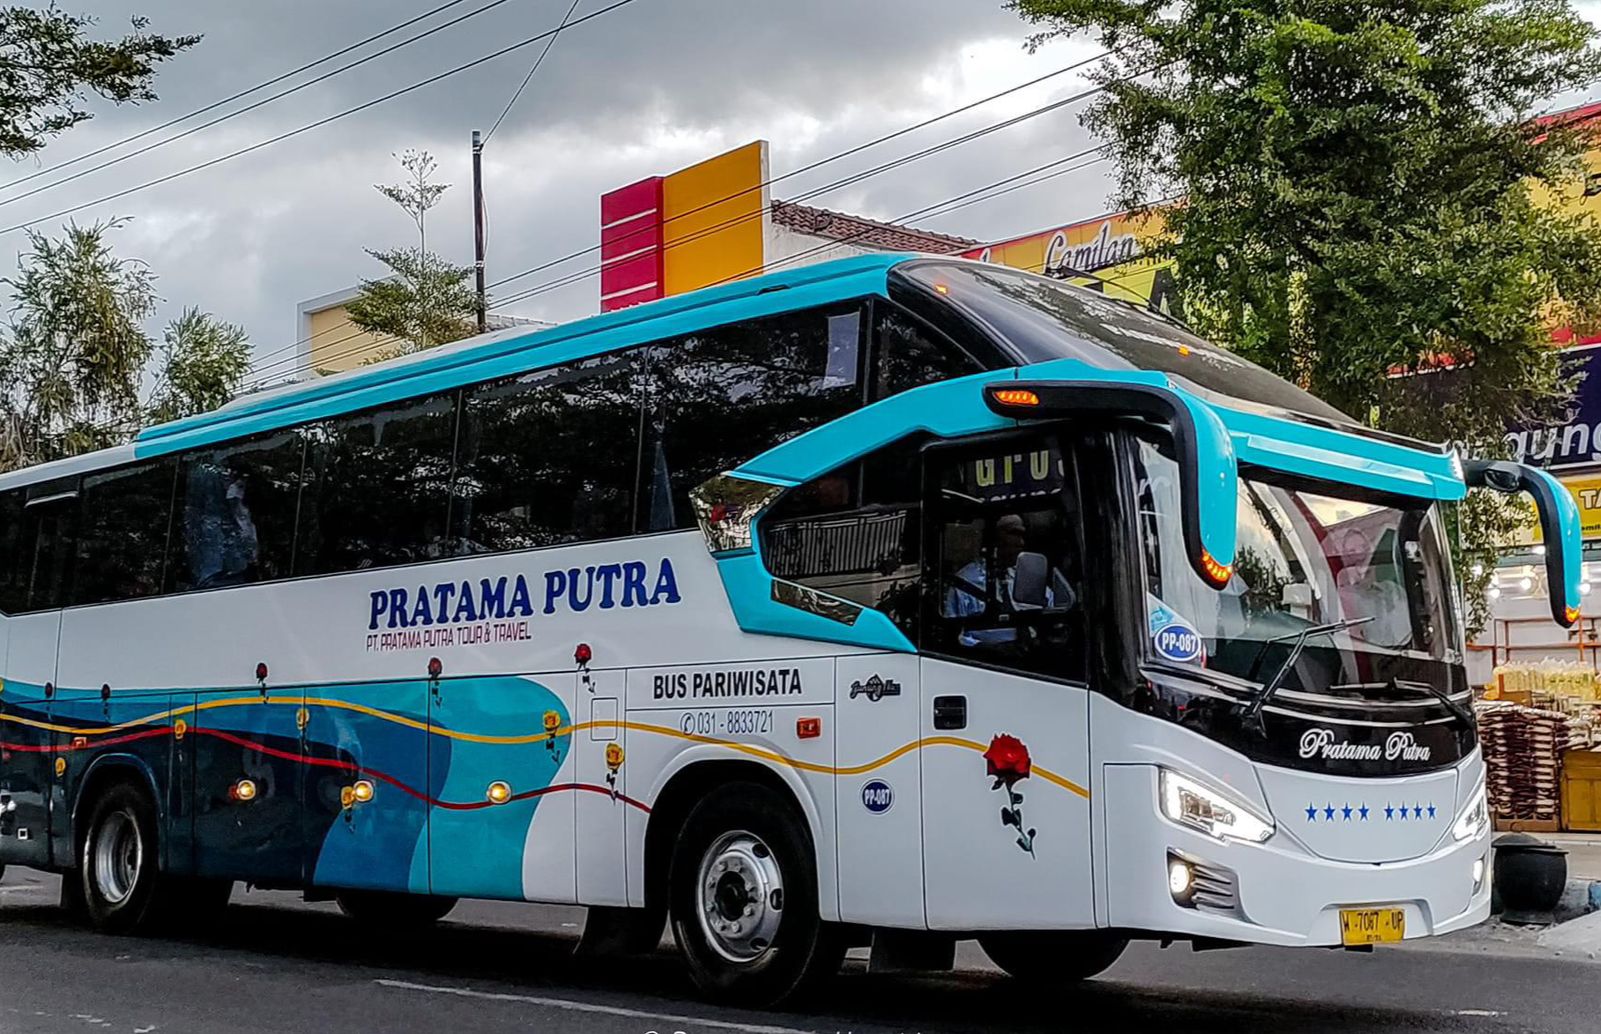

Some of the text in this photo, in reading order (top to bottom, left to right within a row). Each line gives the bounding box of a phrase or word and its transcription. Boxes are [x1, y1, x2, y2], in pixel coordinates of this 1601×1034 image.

[367, 557, 682, 630] PRATAMA PUTRA
[380, 631, 422, 651] PRATAMA
[424, 628, 454, 648] PUTRA
[457, 625, 482, 646] TOUR
[484, 622, 491, 643] &
[494, 621, 532, 643] TRAVEL
[1162, 632, 1196, 653] PP-087
[653, 668, 802, 699] BUS PARIWISATA
[697, 712, 716, 734] 031
[727, 710, 773, 734] 8833721
[1299, 728, 1431, 760] Pratama Putra
[864, 788, 890, 805] PP-087
[1391, 911, 1404, 931] UP
